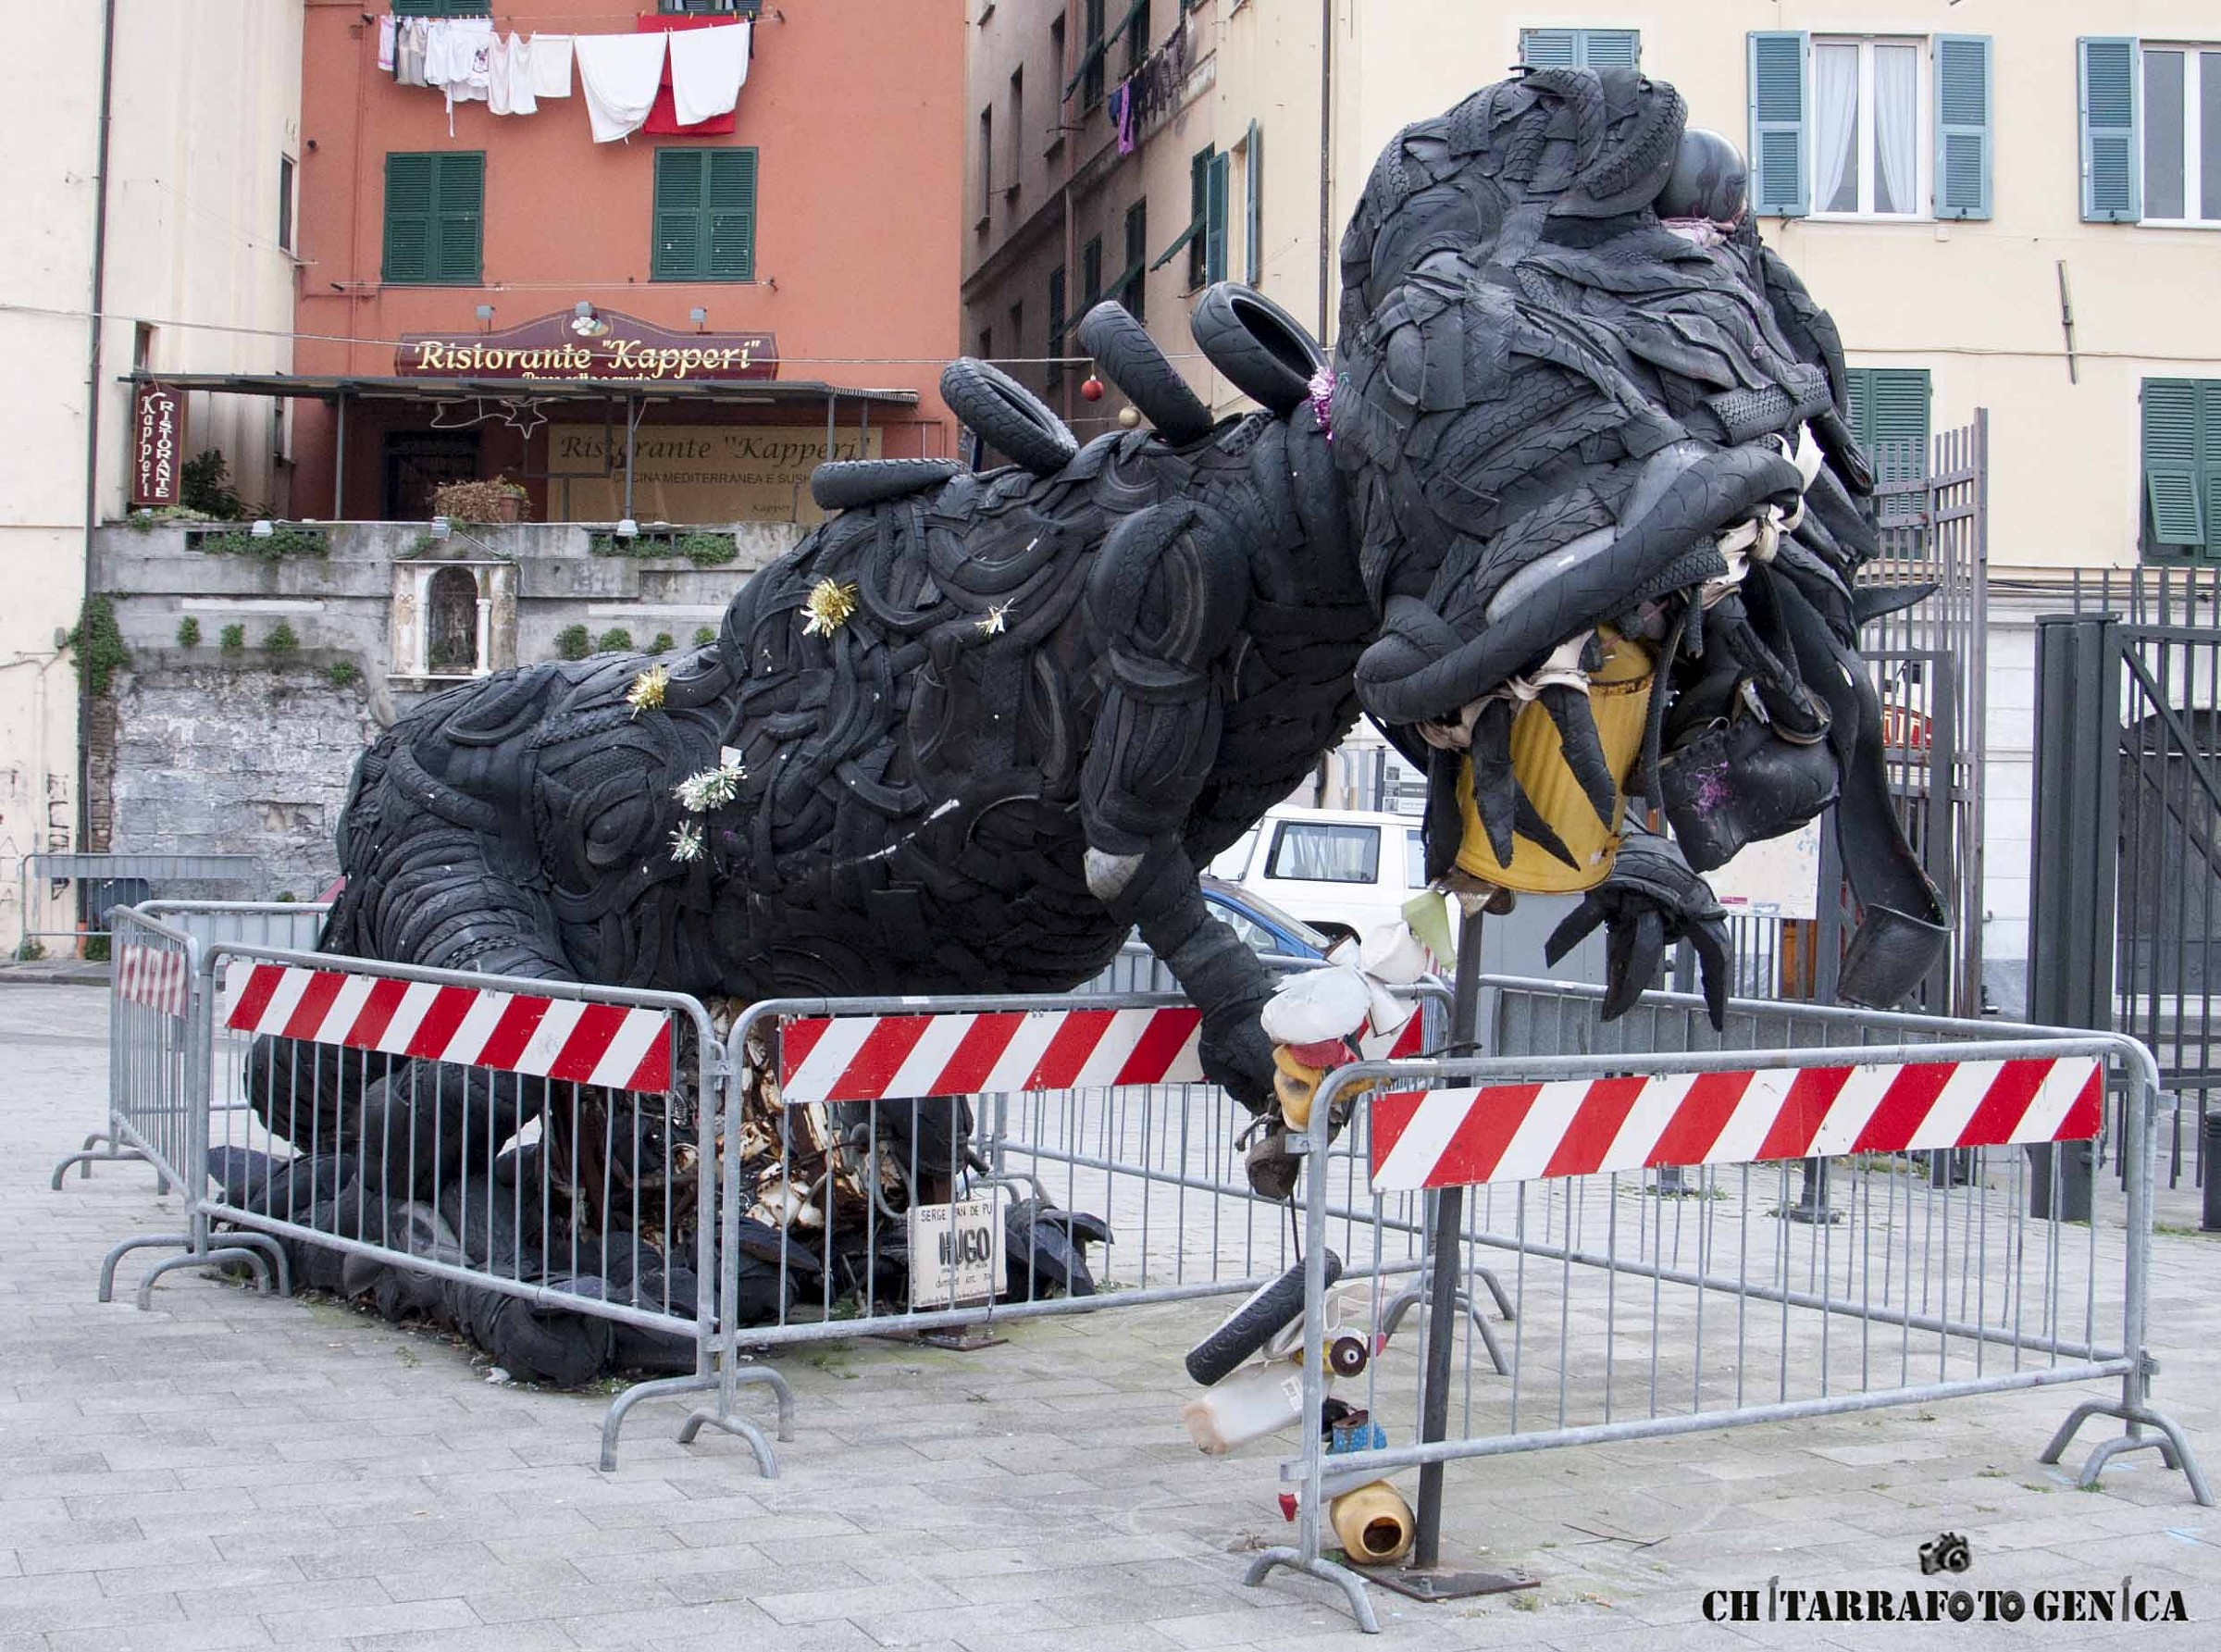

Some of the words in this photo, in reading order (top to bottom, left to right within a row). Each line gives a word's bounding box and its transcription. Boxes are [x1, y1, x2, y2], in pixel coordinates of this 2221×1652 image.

[416, 340, 592, 370] Ristorante
[602, 339, 761, 379] "Kapperi"
[139, 391, 167, 497] Kapperi
[155, 400, 175, 498] RISTORANTE
[921, 1209, 947, 1222] SERGE
[952, 1207, 966, 1216] AN
[938, 1226, 991, 1266] HUGO
